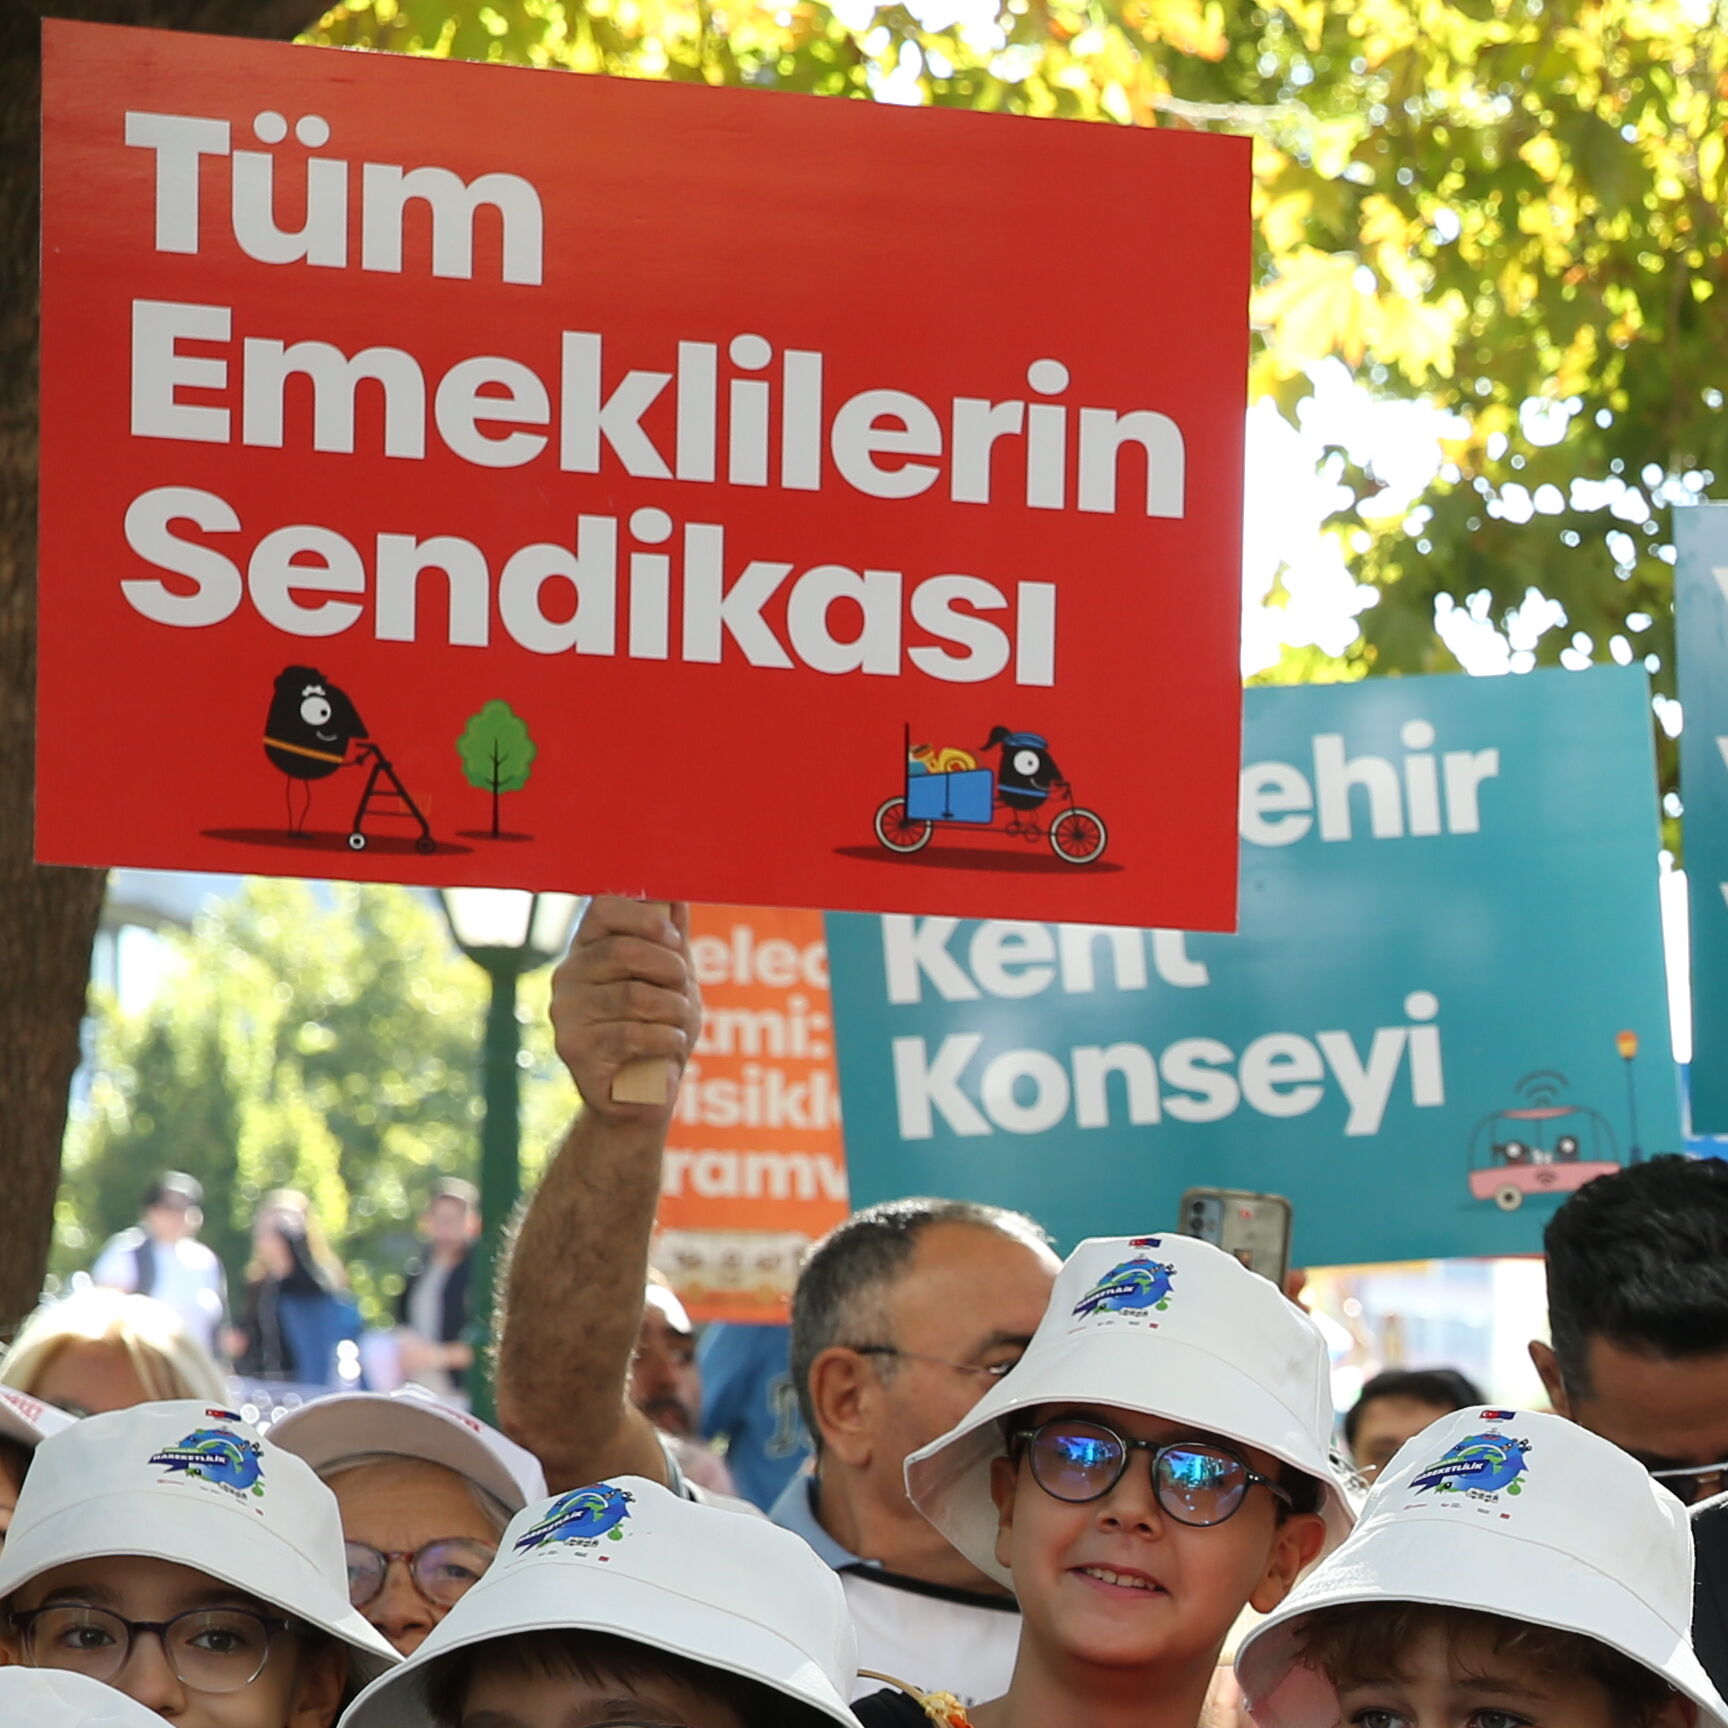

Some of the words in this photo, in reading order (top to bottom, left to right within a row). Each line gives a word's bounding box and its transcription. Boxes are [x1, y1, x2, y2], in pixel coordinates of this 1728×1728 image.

[123, 110, 545, 286] Tüm
[130, 297, 1188, 520] Emeklilerin
[119, 484, 1058, 688] Sendikası
[890, 990, 1445, 1142] Konseyi
